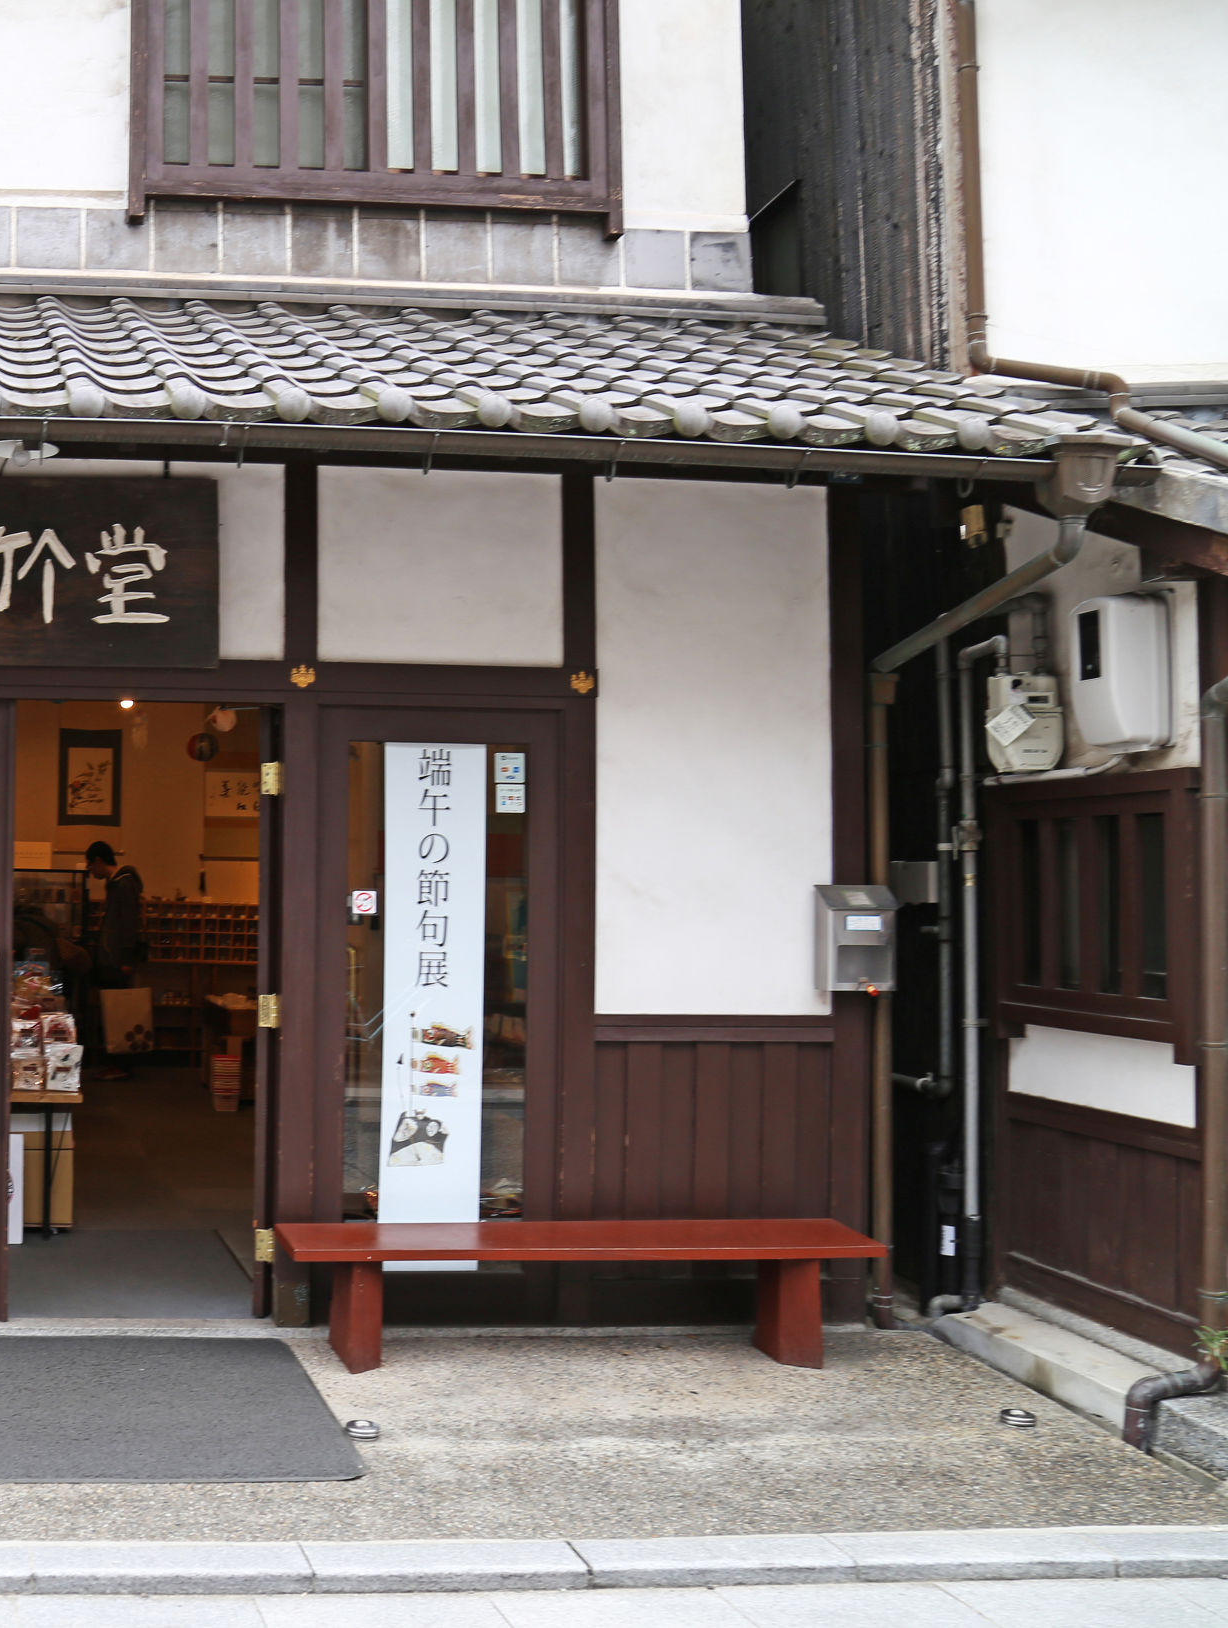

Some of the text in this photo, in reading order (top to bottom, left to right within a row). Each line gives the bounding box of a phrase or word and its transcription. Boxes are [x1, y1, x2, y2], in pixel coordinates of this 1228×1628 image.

[415, 748, 452, 988] 端午の節句展
